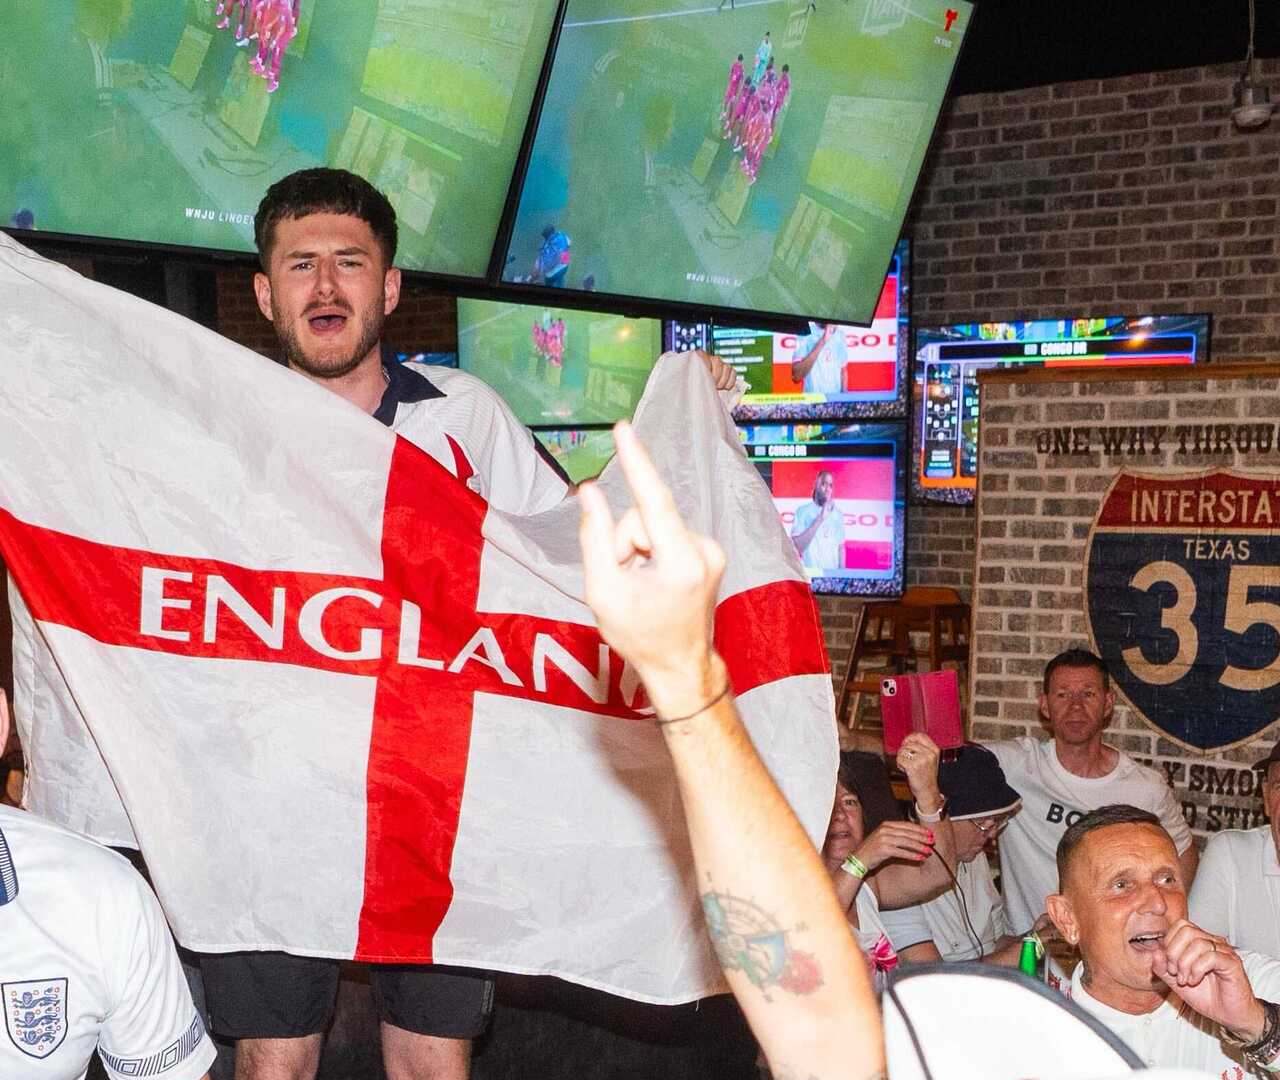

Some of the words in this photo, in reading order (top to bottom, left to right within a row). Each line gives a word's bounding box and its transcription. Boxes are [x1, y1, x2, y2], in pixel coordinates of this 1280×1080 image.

[185, 207, 215, 220] WNJU
[1036, 427, 1090, 456] ONE
[1099, 425, 1166, 456] WAY
[1183, 539, 1251, 560] TEXAS
